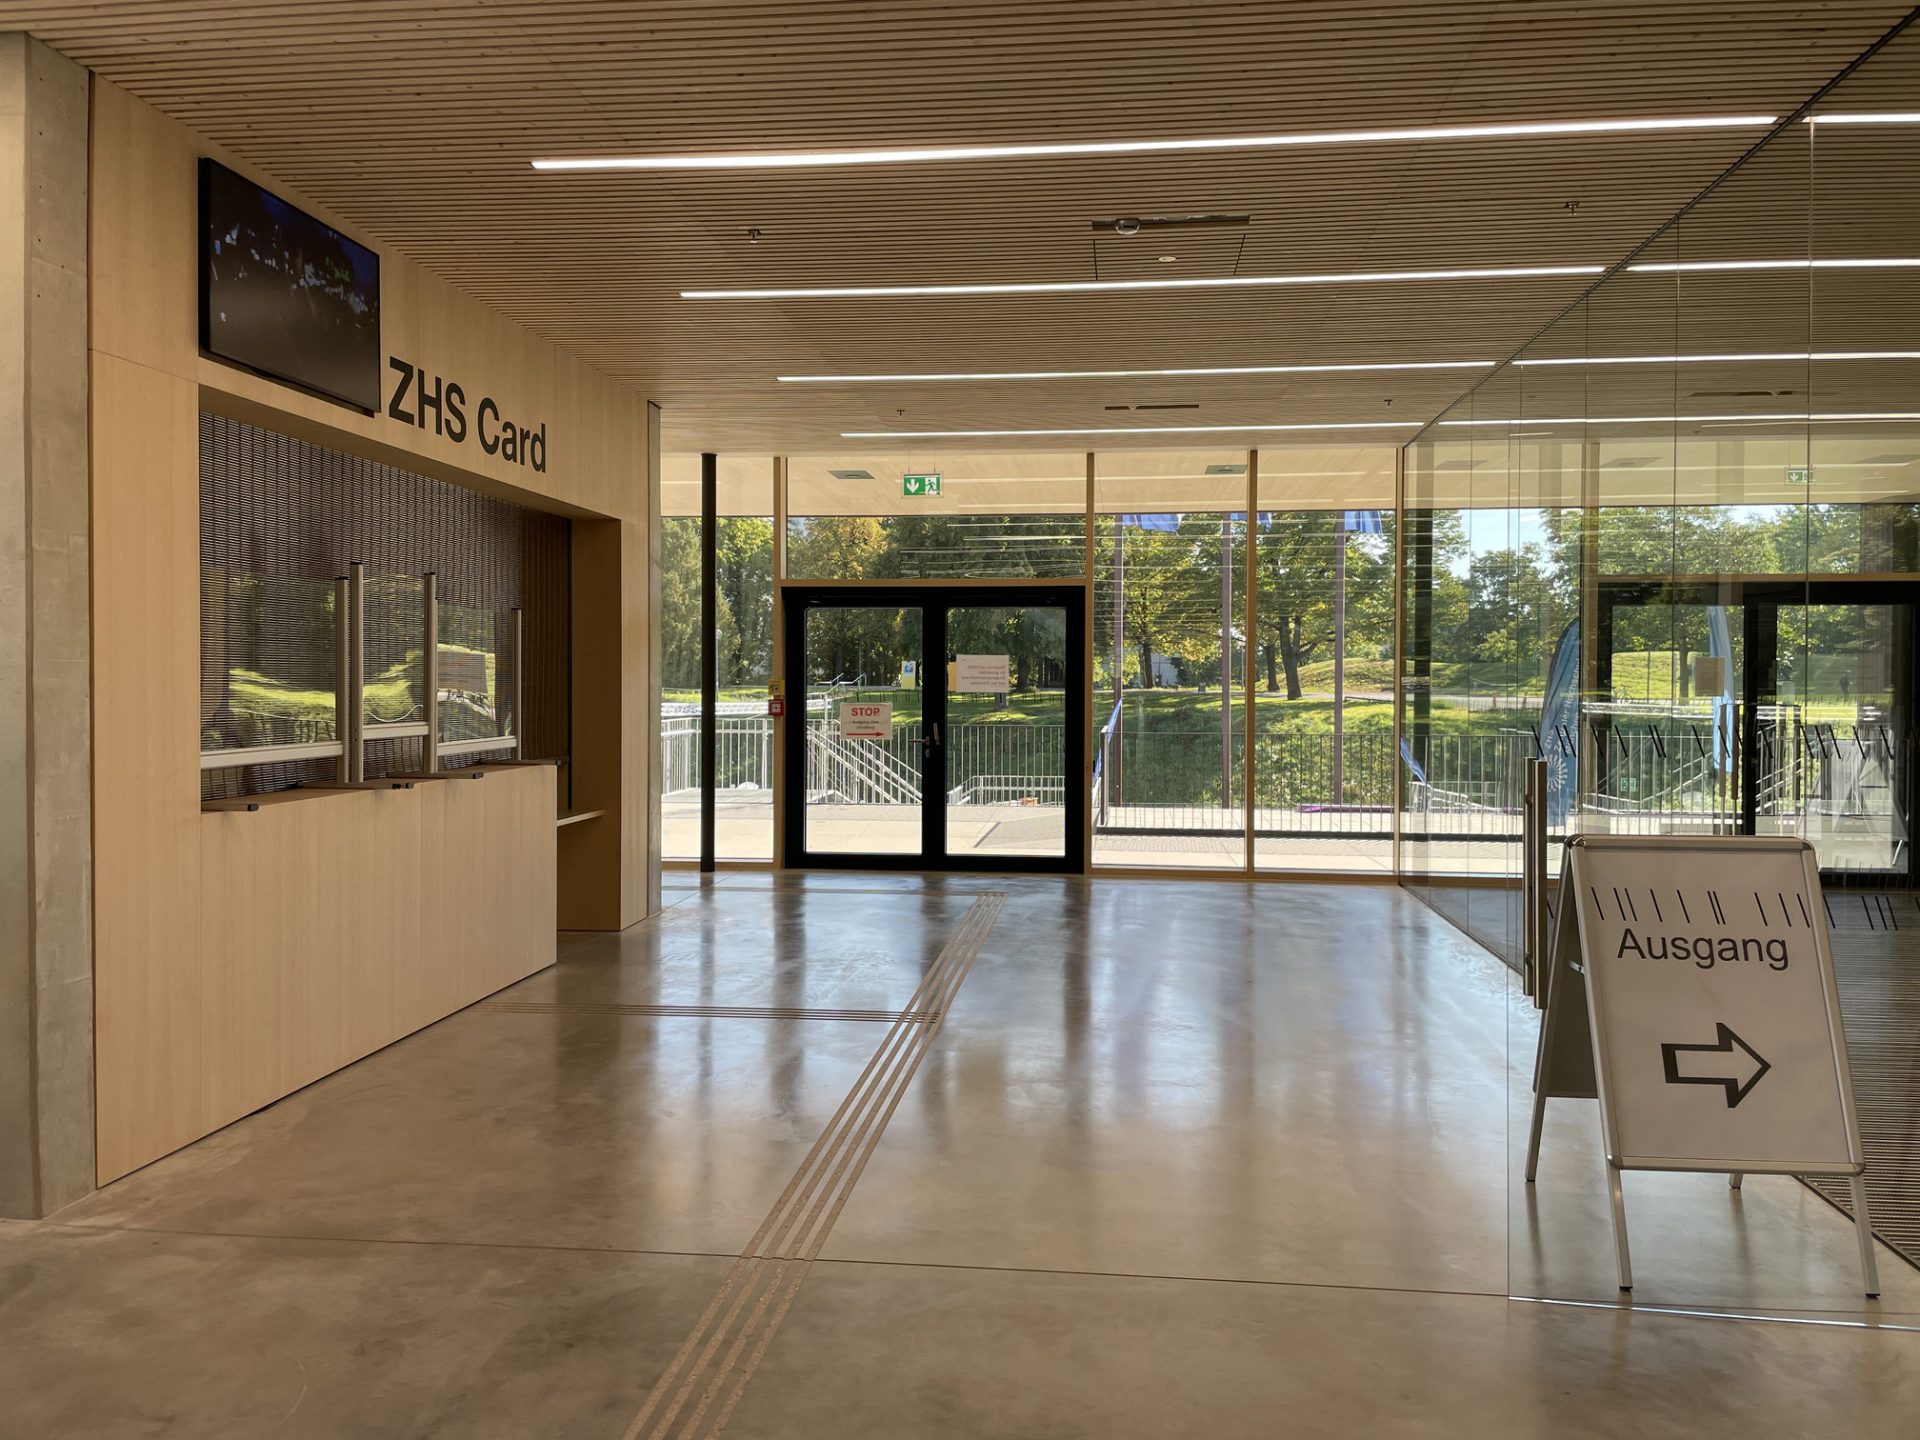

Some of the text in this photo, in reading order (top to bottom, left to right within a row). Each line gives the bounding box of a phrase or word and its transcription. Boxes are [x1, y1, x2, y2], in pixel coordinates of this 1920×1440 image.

[389, 356, 546, 474] ZHS Card
[851, 707, 881, 717] STOP
[1617, 928, 1789, 972] Ausgang
